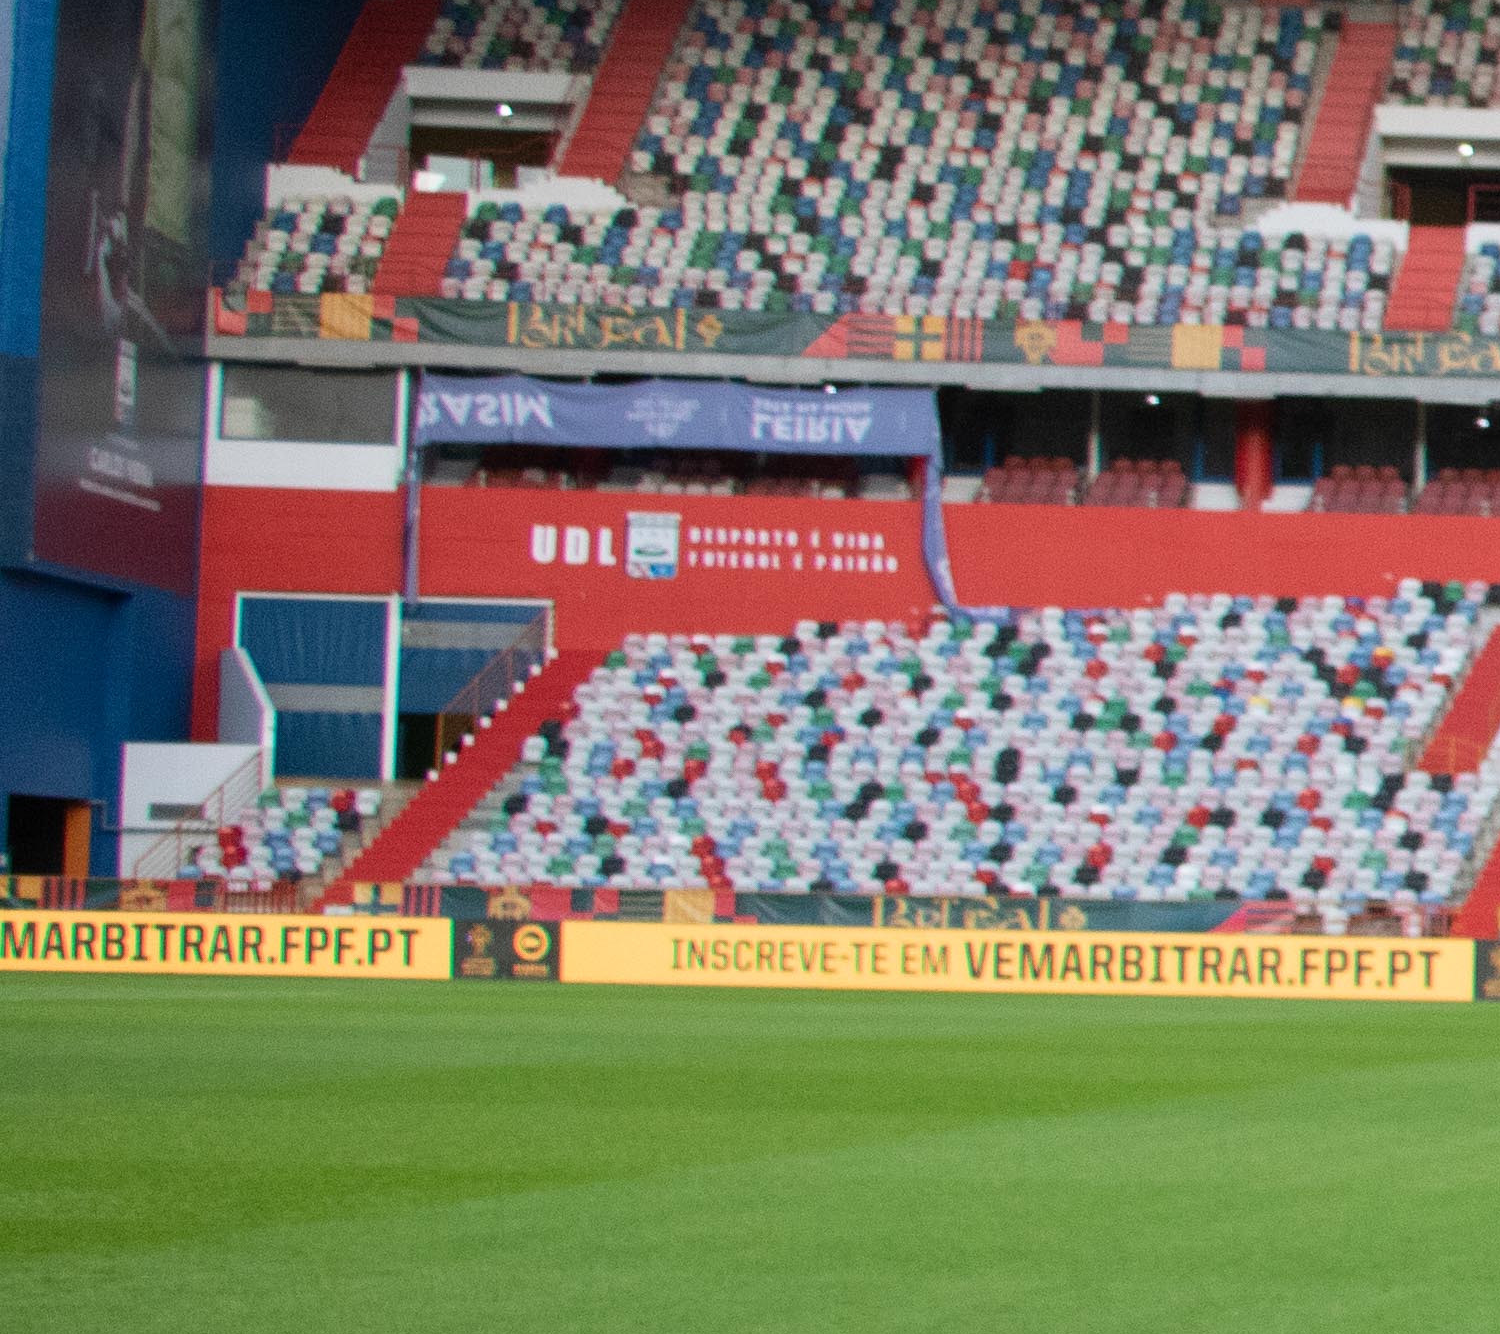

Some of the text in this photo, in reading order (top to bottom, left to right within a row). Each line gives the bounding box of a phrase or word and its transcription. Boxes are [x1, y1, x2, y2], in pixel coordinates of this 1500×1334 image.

[531, 524, 618, 567] UDL
[0, 920, 420, 967] MARBITRAR.FPF.PT
[671, 938, 889, 974] INSCREVE-TE
[901, 944, 949, 975] EM
[966, 941, 1440, 990] VEMARBITRAR.FPF.PT
